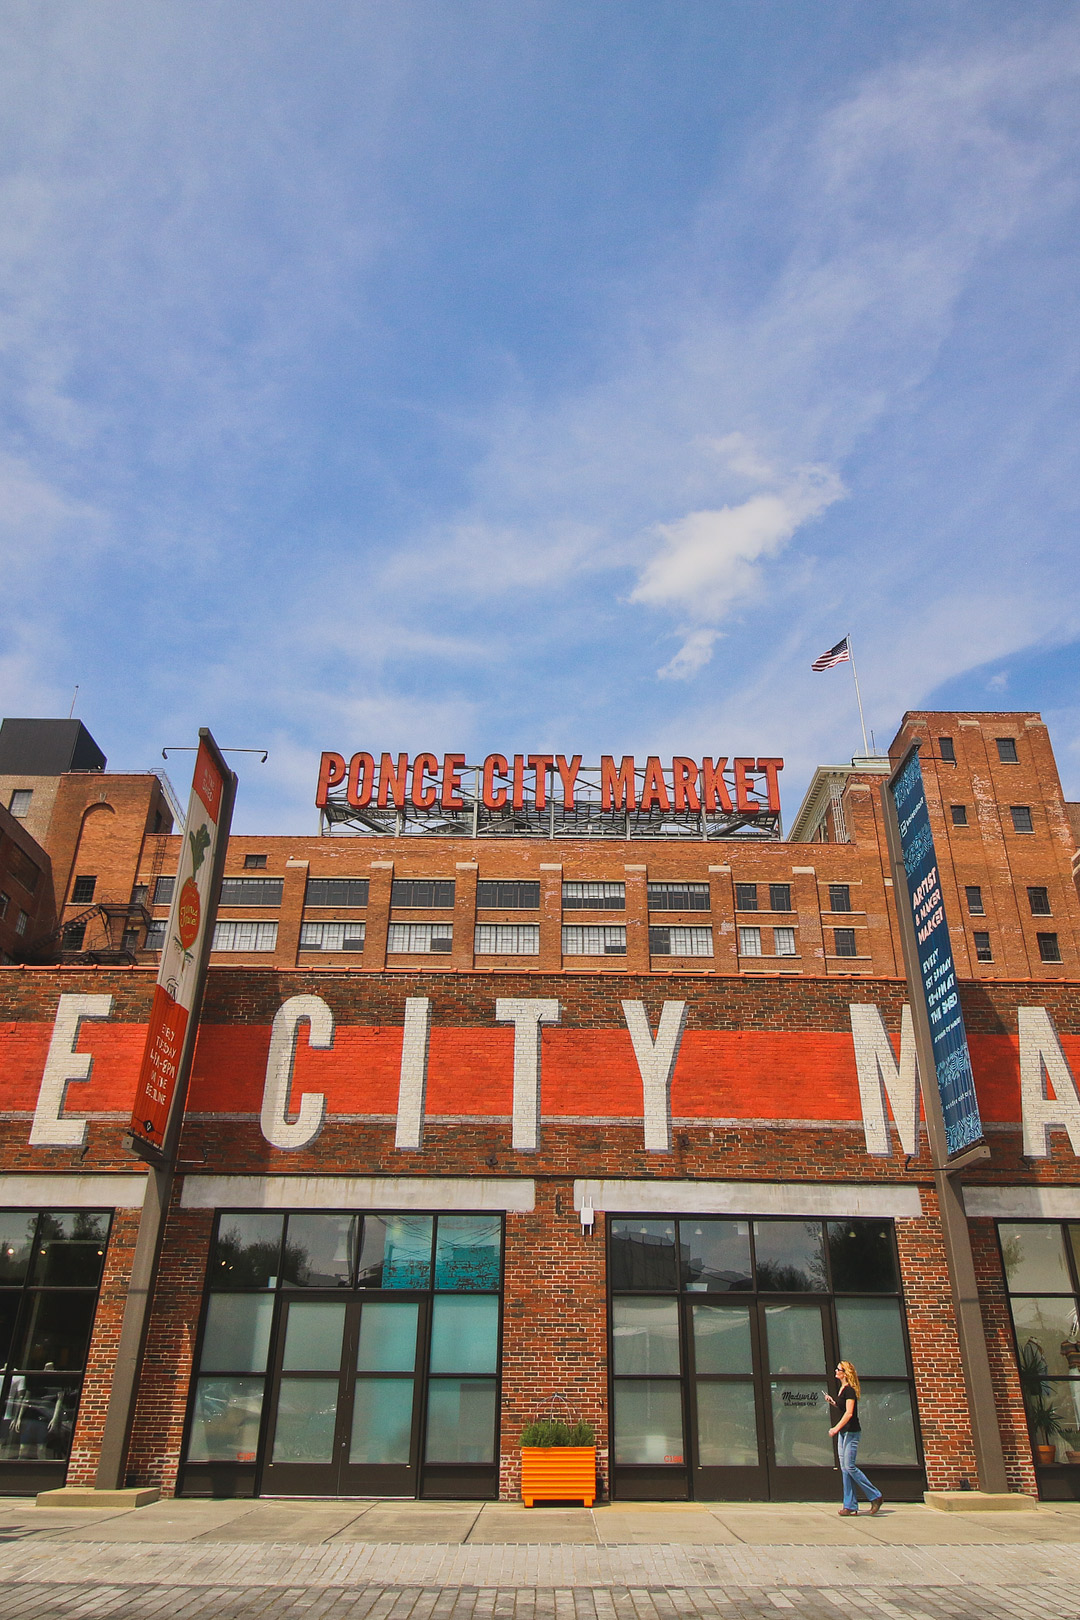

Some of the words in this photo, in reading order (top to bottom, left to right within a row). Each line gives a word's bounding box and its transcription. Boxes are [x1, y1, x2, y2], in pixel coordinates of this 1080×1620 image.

[316, 751, 466, 811] PONCE
[482, 753, 583, 812] CITY
[601, 755, 784, 814] MARKET
[912, 866, 937, 911] ARTIST
[917, 905, 944, 946] MARKET
[260, 993, 689, 1154] CITY
